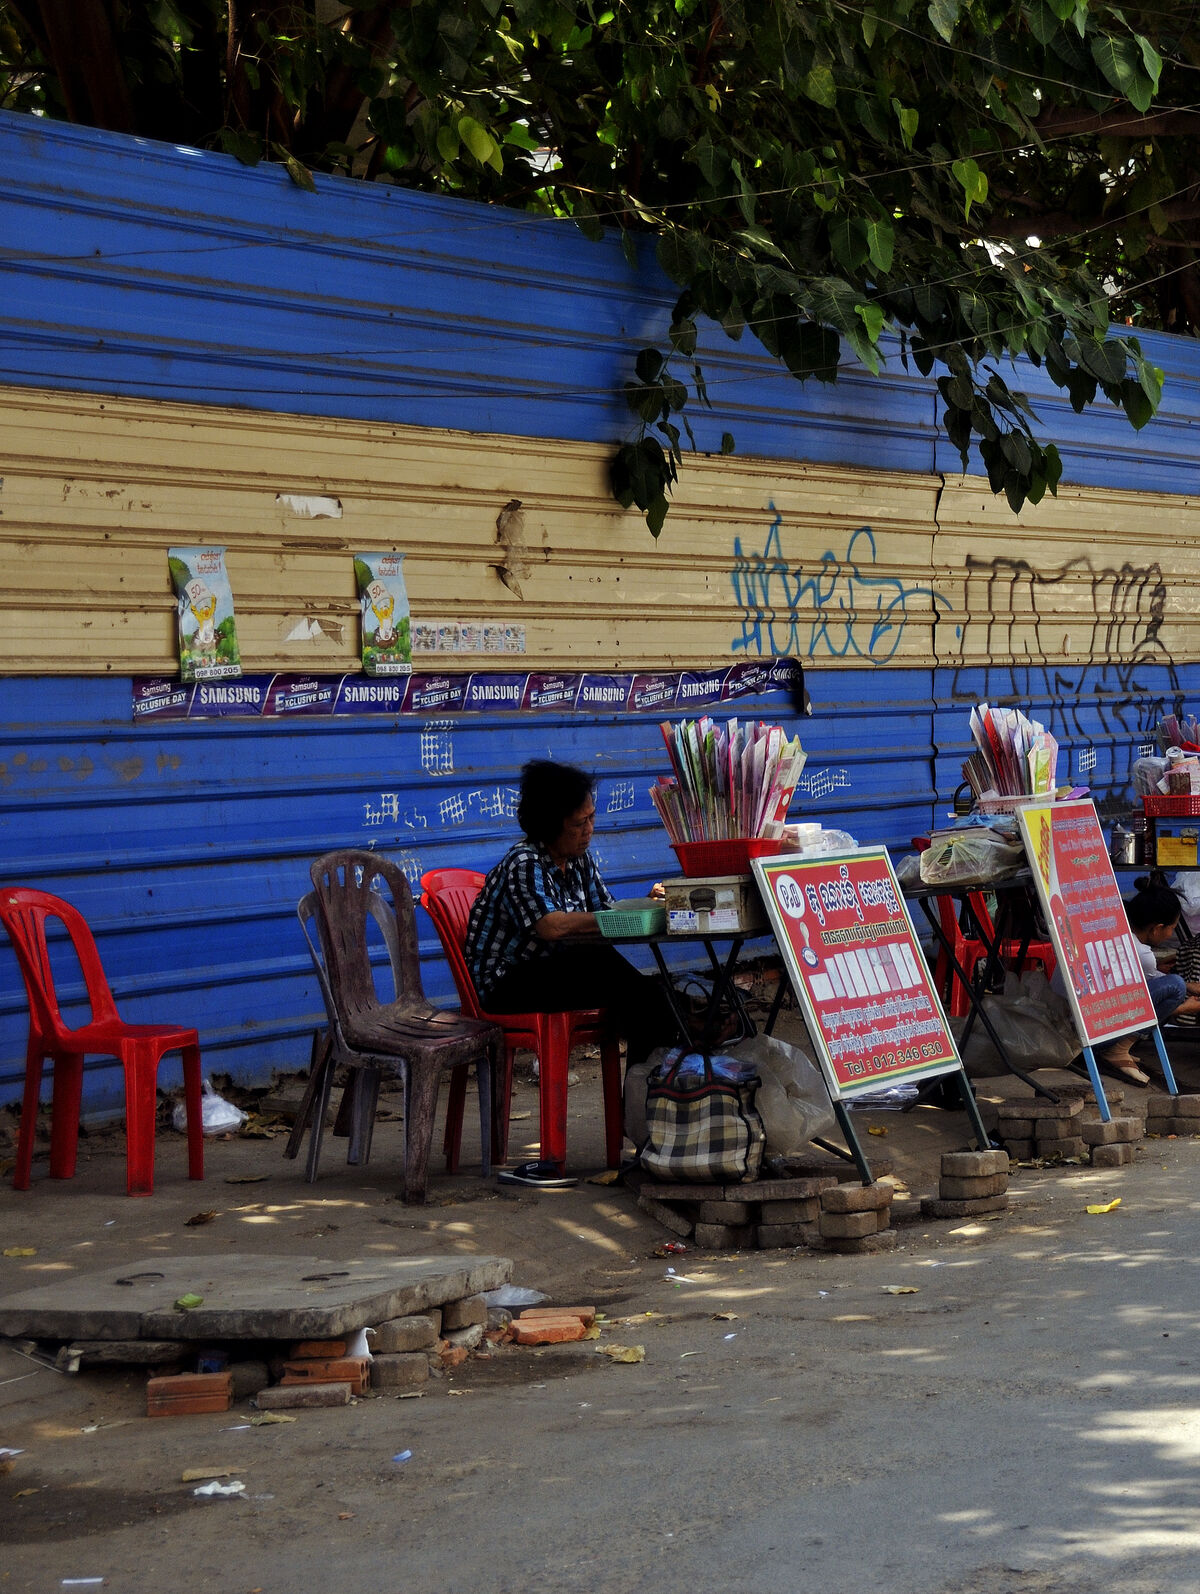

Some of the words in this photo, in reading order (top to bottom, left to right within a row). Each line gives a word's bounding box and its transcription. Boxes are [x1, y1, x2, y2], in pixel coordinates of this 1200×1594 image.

[223, 666, 239, 675] 205
[142, 682, 171, 697] Samsung
[290, 681, 319, 693] Samsung
[425, 680, 450, 691] Samsung
[472, 685, 520, 700] SAMSUNG
[542, 680, 564, 690] Samsung
[645, 681, 665, 691] Samsung
[682, 679, 720, 698] SAMSUNG
[200, 687, 261, 704] SAMSUNG
[318, 690, 332, 700] DAY
[344, 686, 400, 702] SAMSUNG
[412, 692, 449, 709] EXCLUSIVE
[450, 689, 462, 699] DAY
[583, 686, 625, 701] SAMSUNG
[132, 697, 171, 713] XCLUSIVE
[172, 692, 187, 703] DAY
[844, 1058, 865, 1077] Tel
[873, 1051, 898, 1070] 012
[897, 1045, 921, 1064] 346
[921, 1040, 944, 1059] 630
